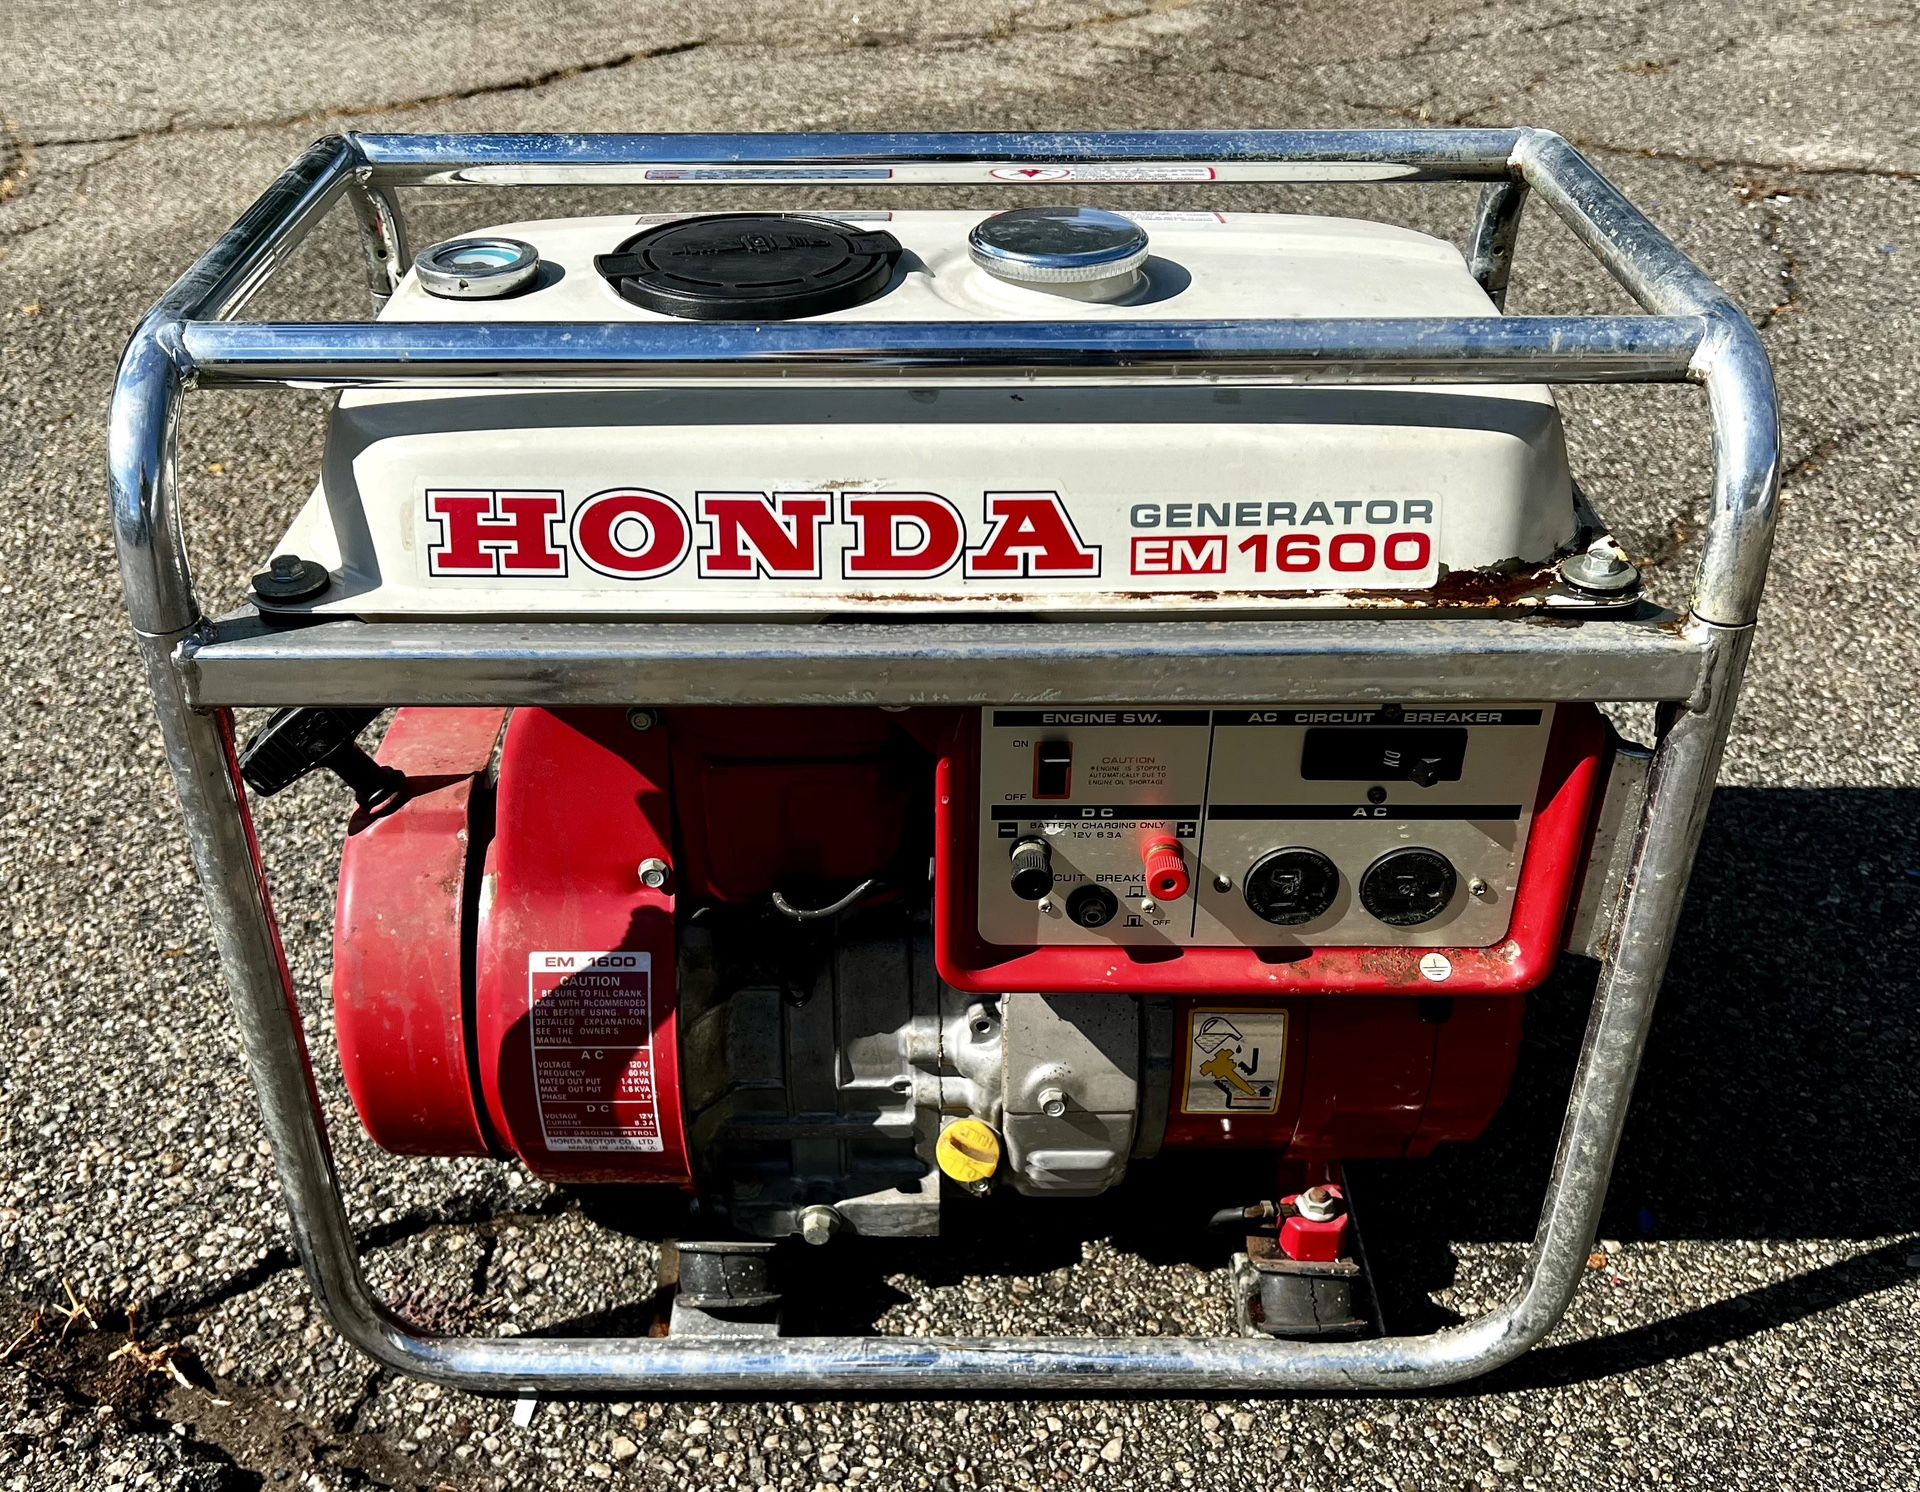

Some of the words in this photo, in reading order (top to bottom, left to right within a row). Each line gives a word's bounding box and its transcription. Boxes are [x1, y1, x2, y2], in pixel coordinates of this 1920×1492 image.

[1130, 499, 1434, 528] GENERATOR
[425, 487, 1102, 580] HONDA
[1134, 538, 1225, 572] EM
[1237, 532, 1431, 573] 1600
[1042, 713, 1117, 724] ENGINE
[1247, 712, 1278, 723] AC
[1294, 712, 1376, 723] CIRCUIT
[1403, 712, 1503, 723] BREAKER
[1012, 740, 1029, 748] ON
[1102, 756, 1155, 764] CAUTION
[1004, 793, 1027, 801] OFF
[1030, 822, 1079, 830] BATTERY
[1081, 822, 1137, 830] CHARGING
[1139, 821, 1166, 829] ONLY
[1072, 831, 1092, 839] 12V
[1053, 873, 1086, 883] CUIT
[1096, 873, 1147, 883] BREAKE
[545, 956, 574, 967] EM
[587, 956, 637, 967] 1600
[560, 976, 620, 987] CAUTION
[541, 989, 553, 998] BE
[554, 989, 577, 998] SURE
[580, 989, 591, 998] TO
[594, 989, 611, 998] FILL
[534, 999, 556, 1007] CASE
[559, 999, 580, 1007] WITH
[584, 999, 646, 1007] RECOMMENDED
[535, 1009, 549, 1017] OIL
[552, 1009, 586, 1017] BEFORE
[629, 1008, 646, 1016] FOR
[535, 1018, 575, 1026] DETAILED
[535, 1027, 551, 1035] SEE
[557, 1027, 574, 1035] THE
[580, 1027, 619, 1035] OWNER'S
[537, 1061, 572, 1069] VOLTAGE
[539, 1069, 586, 1077] FREQUENCY
[540, 1077, 565, 1085] RATED
